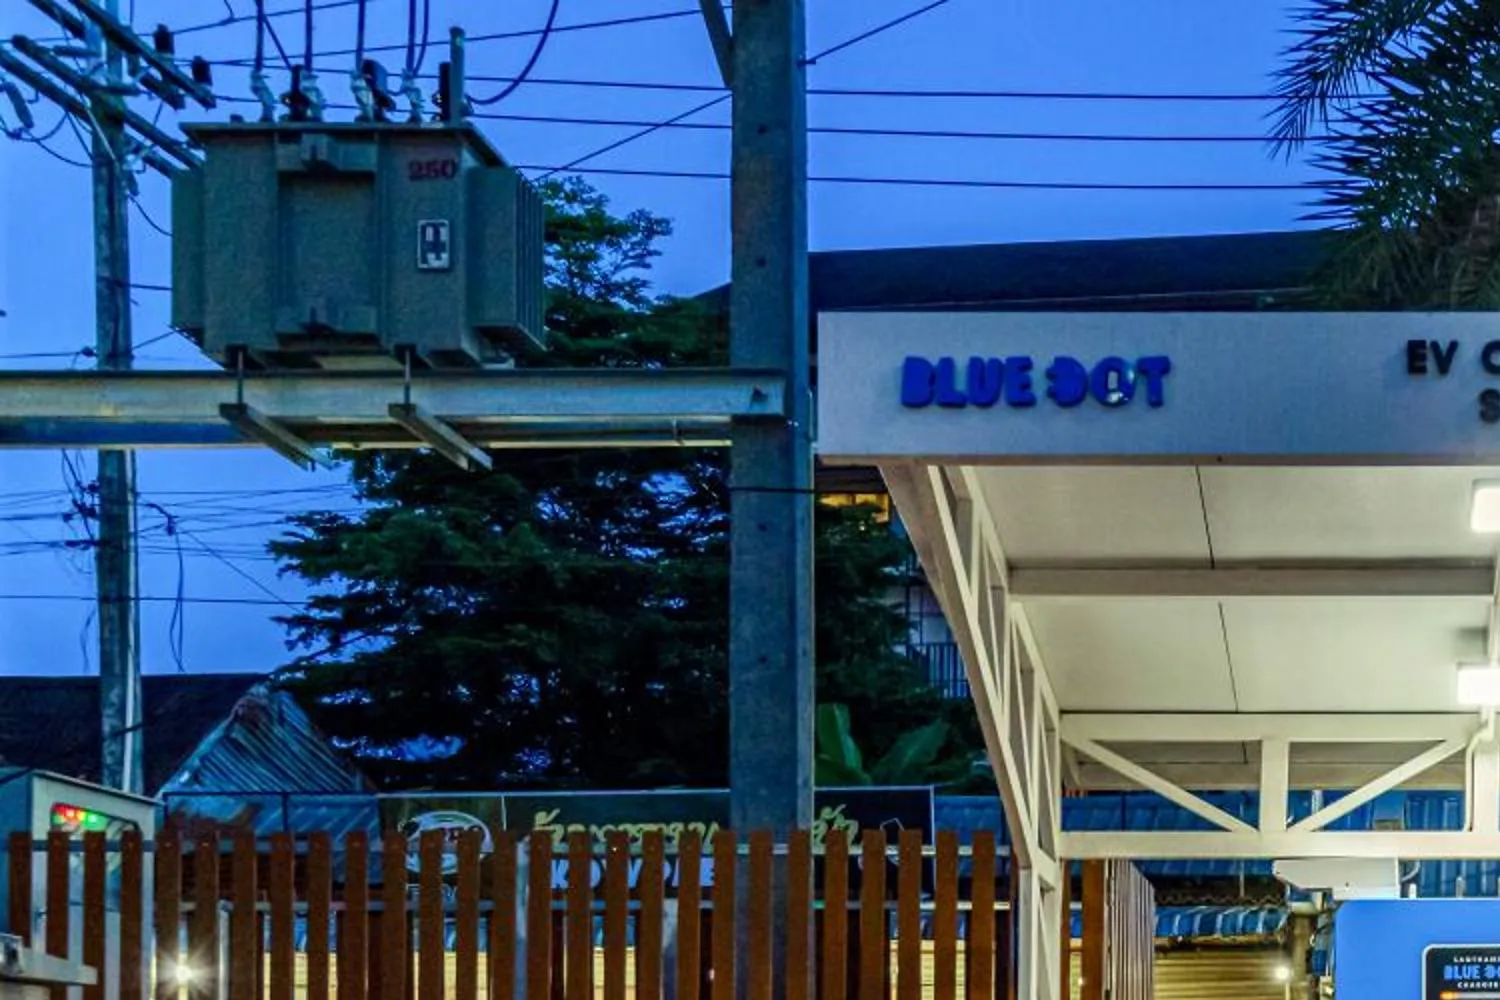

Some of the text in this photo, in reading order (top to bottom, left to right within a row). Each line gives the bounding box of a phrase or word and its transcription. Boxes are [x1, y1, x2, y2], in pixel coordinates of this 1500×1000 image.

[1406, 339, 1459, 376] EV
[901, 355, 1171, 409] BLUE DOT
[1443, 964, 1480, 980] BLUE
